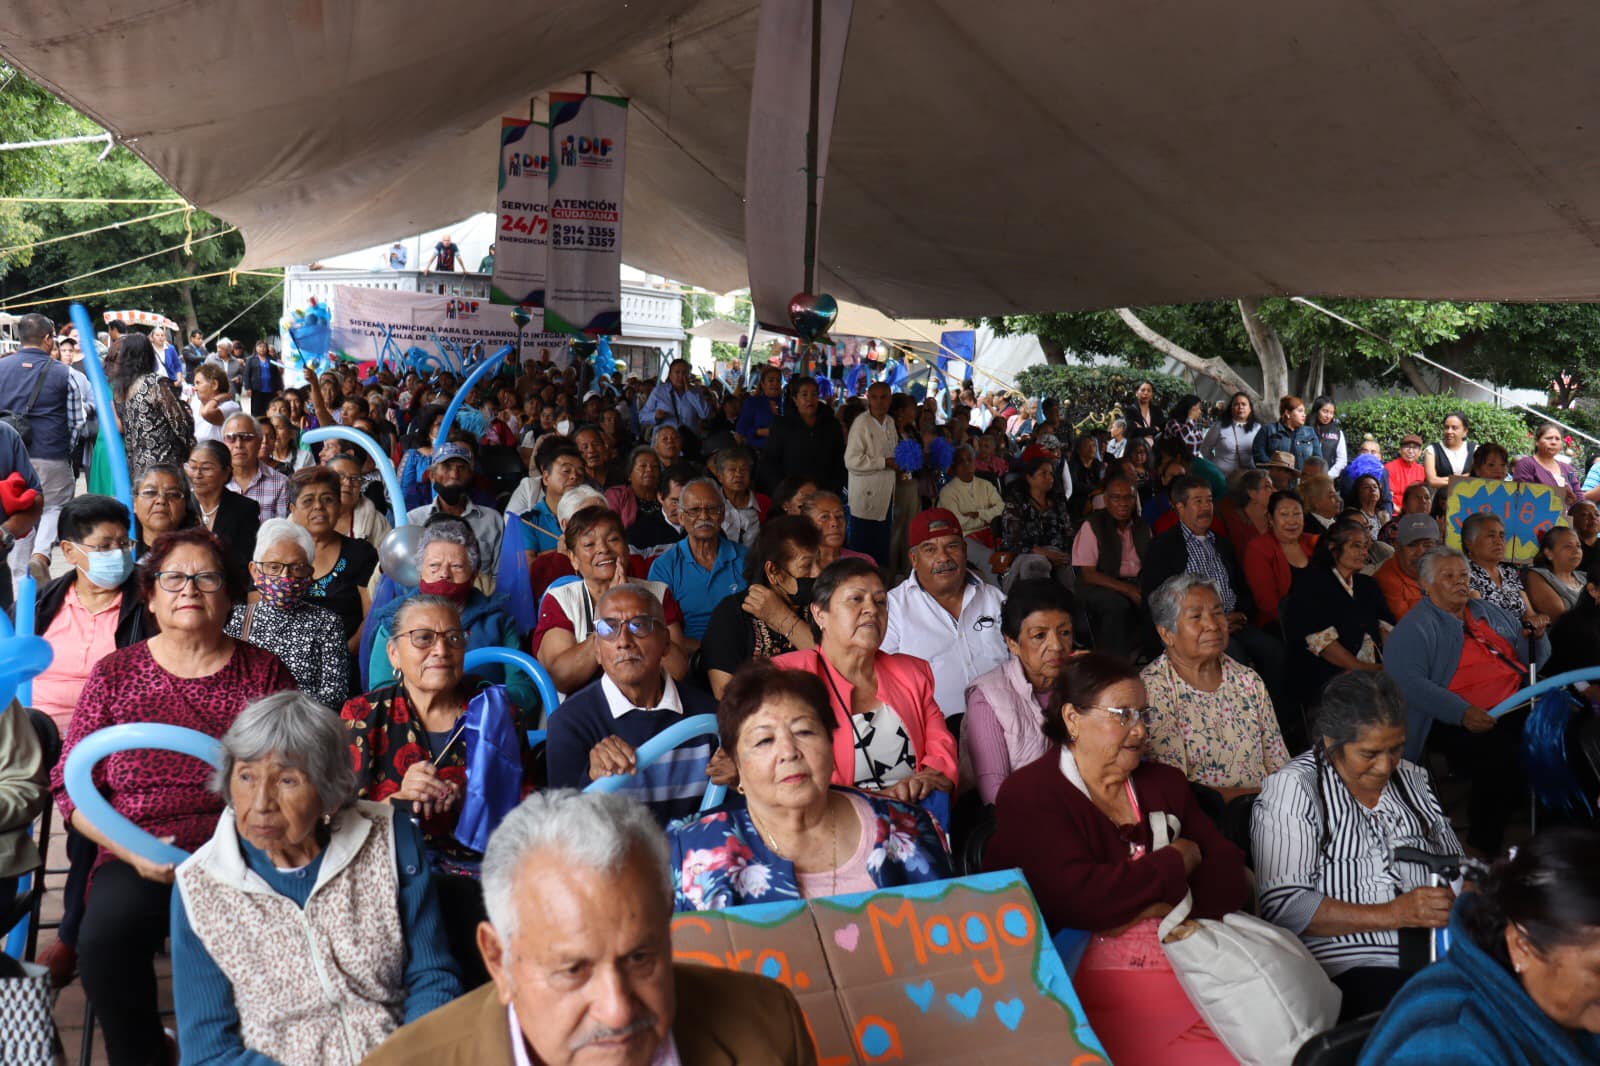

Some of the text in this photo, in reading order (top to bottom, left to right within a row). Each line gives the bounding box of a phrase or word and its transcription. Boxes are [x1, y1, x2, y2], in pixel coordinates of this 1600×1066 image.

[578, 136, 614, 156] DIF
[553, 199, 617, 211] ATENCIÓN
[554, 209, 615, 221] CIUDADANA
[501, 214, 548, 236] 24/7
[563, 225, 616, 238] 914 3355
[563, 235, 616, 248] 914 3357
[457, 300, 480, 314] DIF
[438, 326, 461, 335] PARA
[462, 328, 470, 336] EL
[866, 898, 1036, 985] Mago
